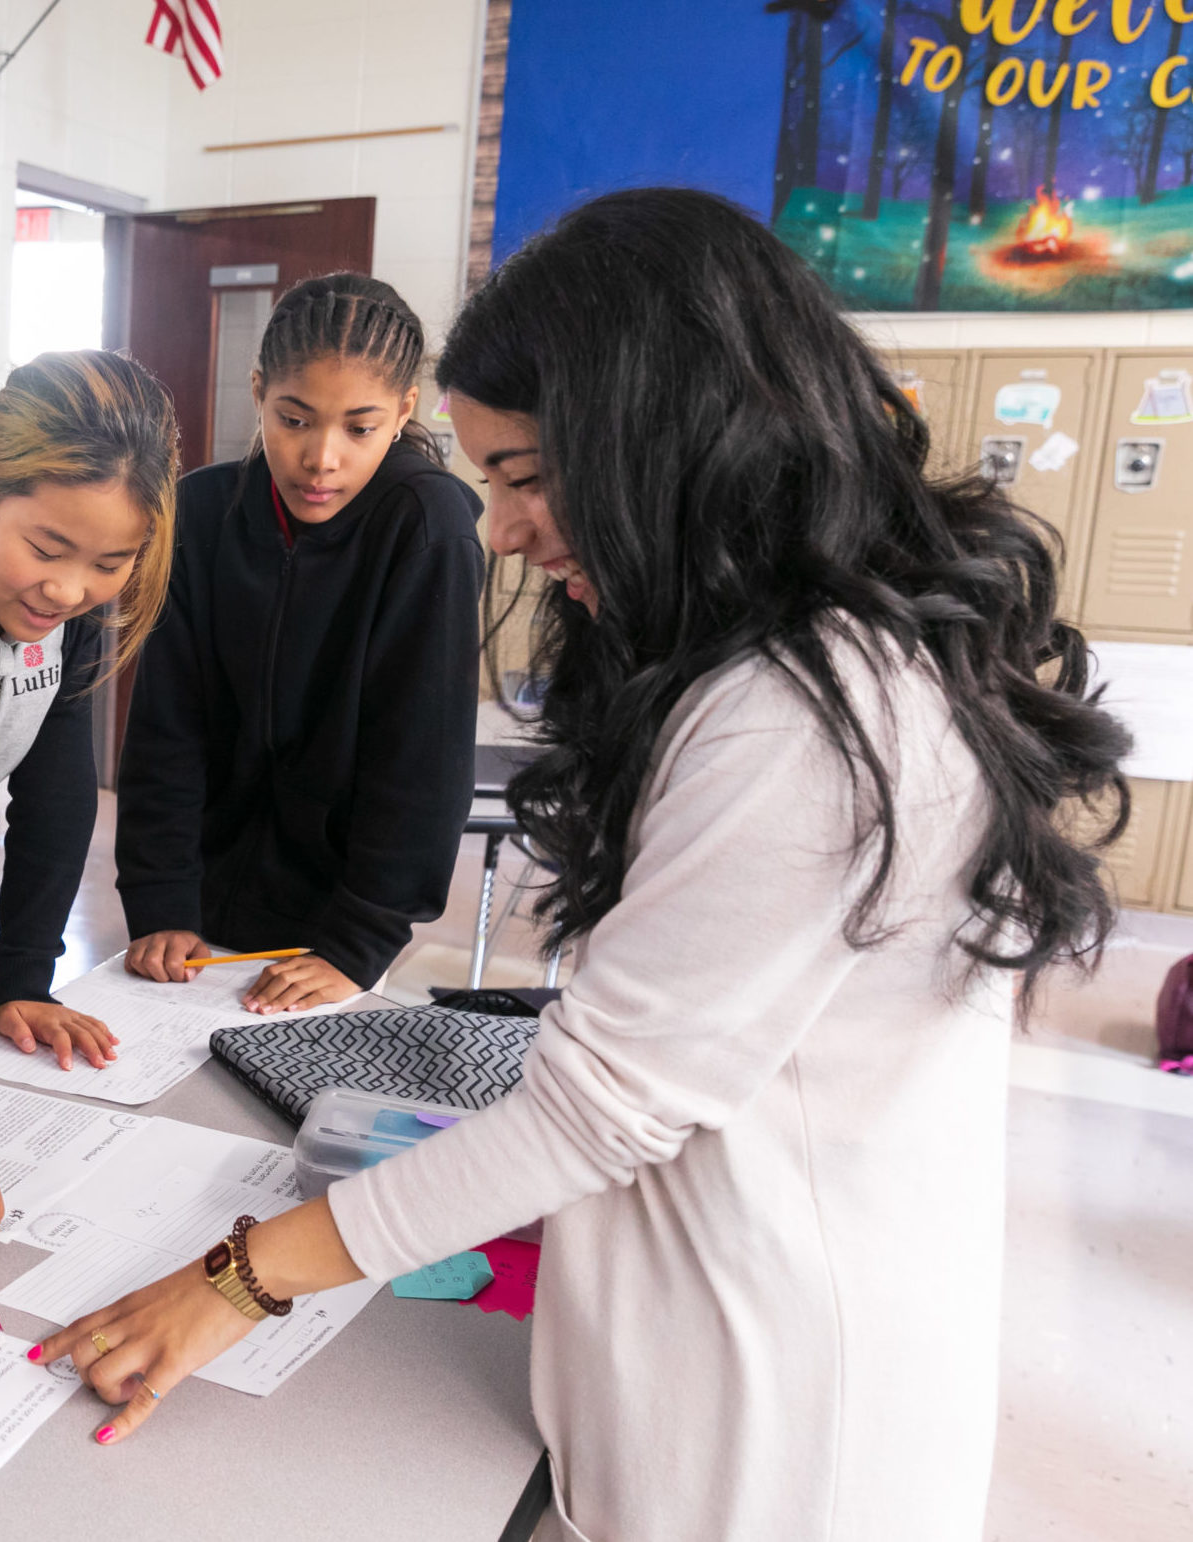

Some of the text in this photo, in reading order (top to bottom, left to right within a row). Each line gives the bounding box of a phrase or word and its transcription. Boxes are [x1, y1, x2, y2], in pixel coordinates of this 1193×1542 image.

[900, 37, 1193, 109] TO OUR C
[11, 664, 60, 696] LuHi
